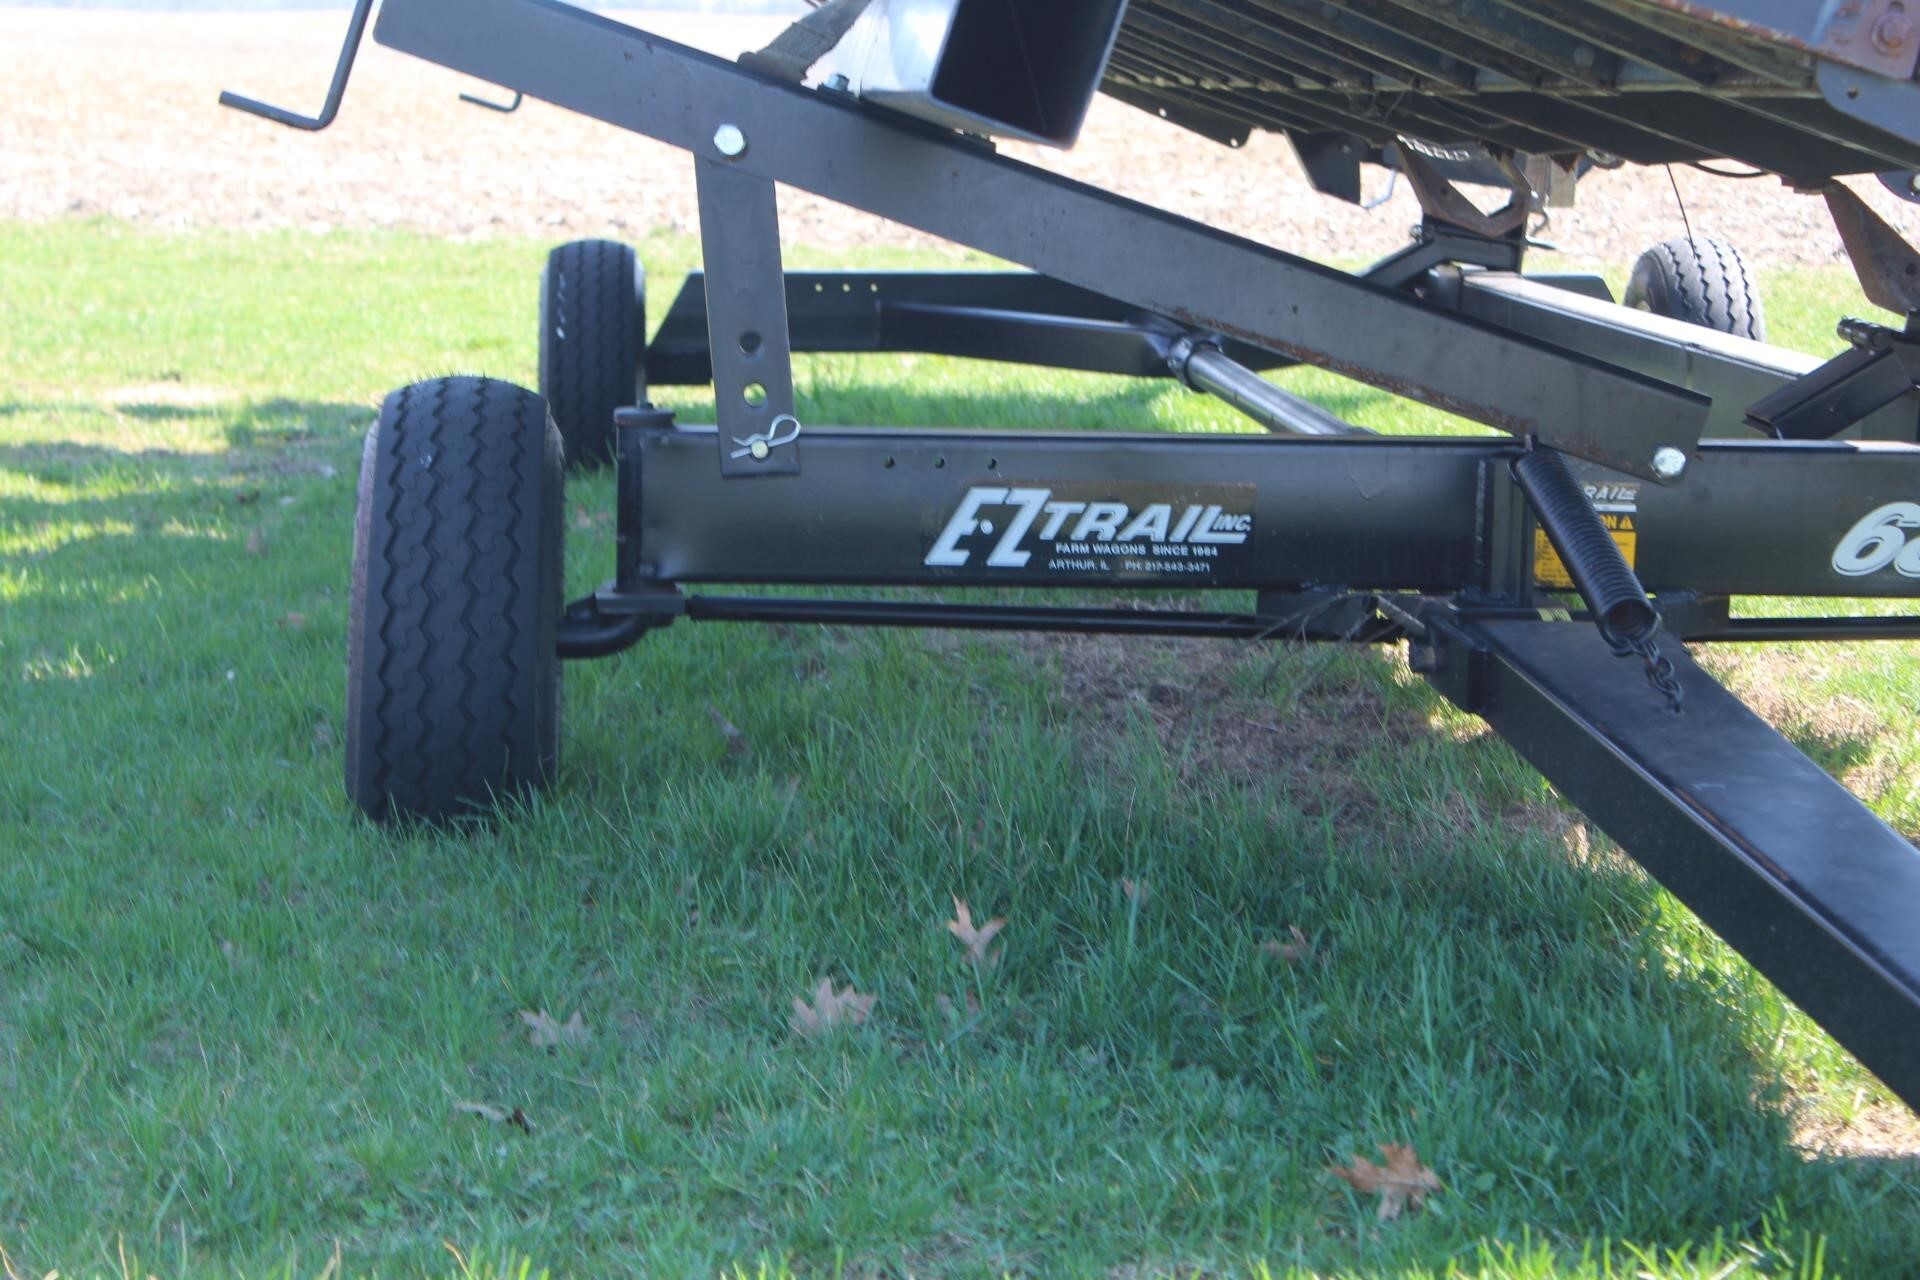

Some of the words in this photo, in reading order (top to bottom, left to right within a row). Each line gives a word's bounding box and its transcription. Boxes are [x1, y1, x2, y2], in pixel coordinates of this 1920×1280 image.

[1582, 485, 1635, 500] RAIL
[1039, 502, 1247, 543] TRAIL
[1055, 542, 1090, 555] FARM
[1092, 543, 1147, 556] WAGONS
[1152, 544, 1189, 557] SINCE
